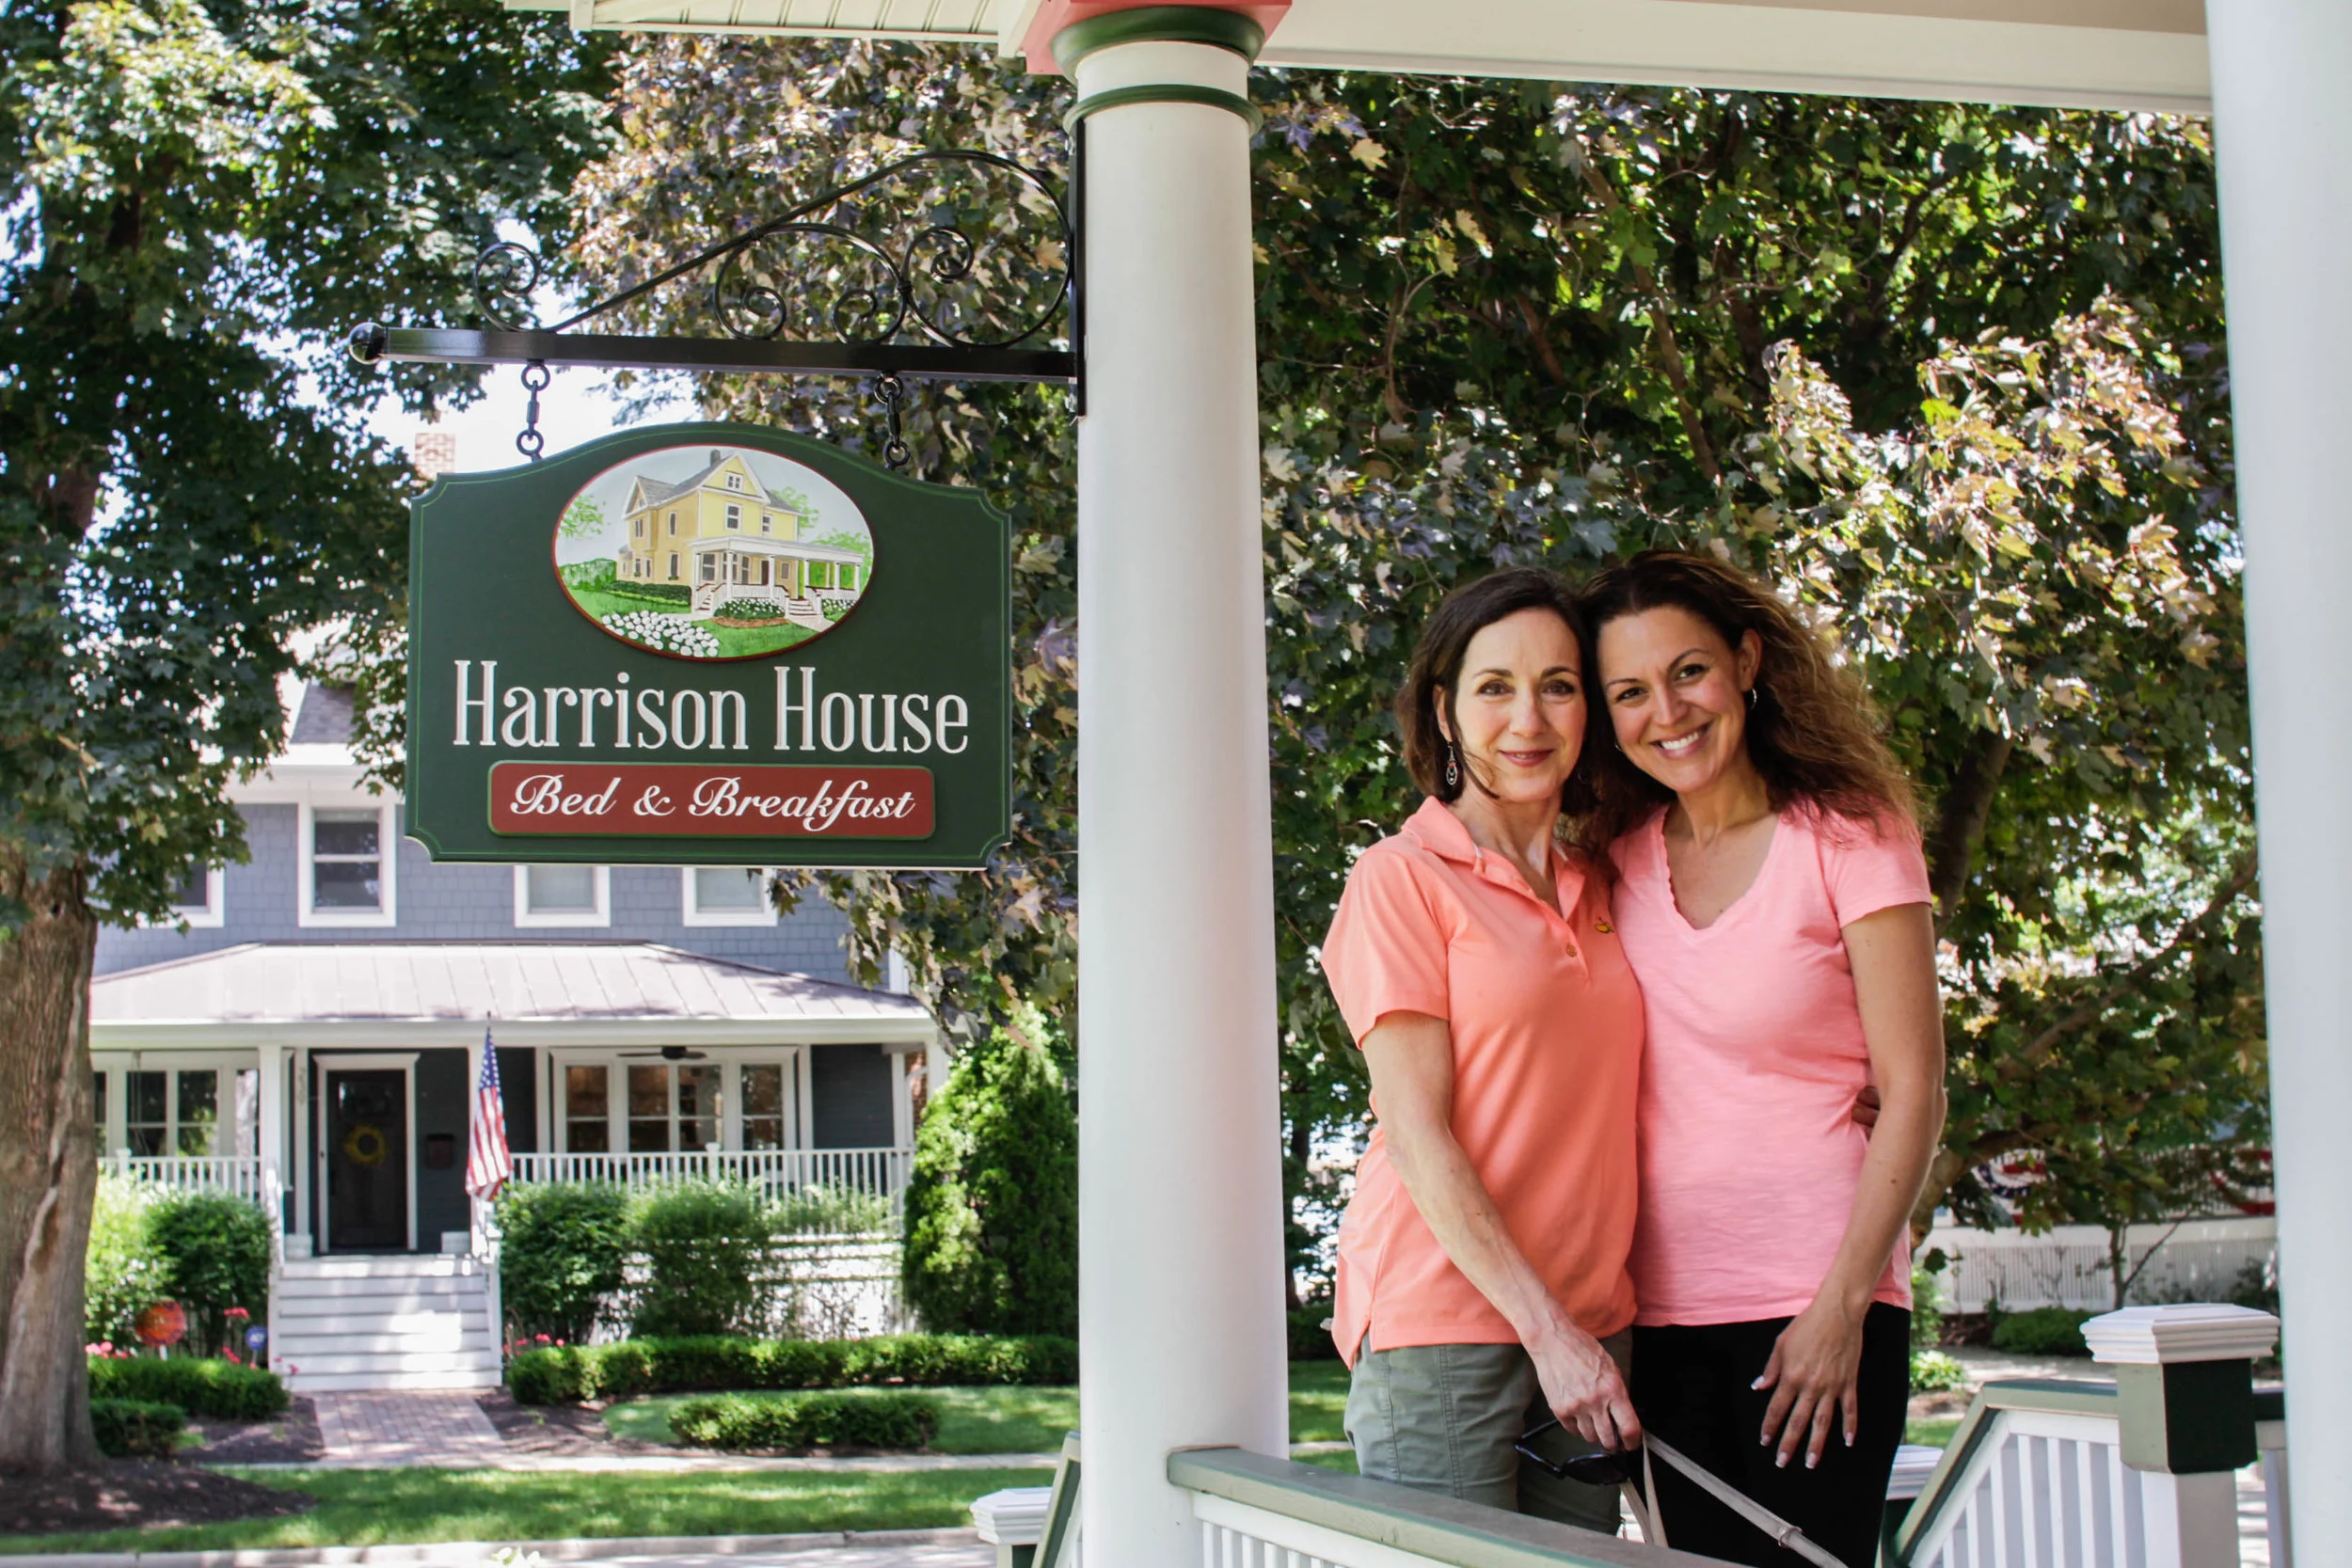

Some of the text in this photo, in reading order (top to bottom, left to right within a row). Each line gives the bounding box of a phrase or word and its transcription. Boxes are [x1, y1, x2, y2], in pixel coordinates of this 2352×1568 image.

[453, 660, 968, 753] Harrison House
[510, 775, 915, 832] Bed & Breakfast
